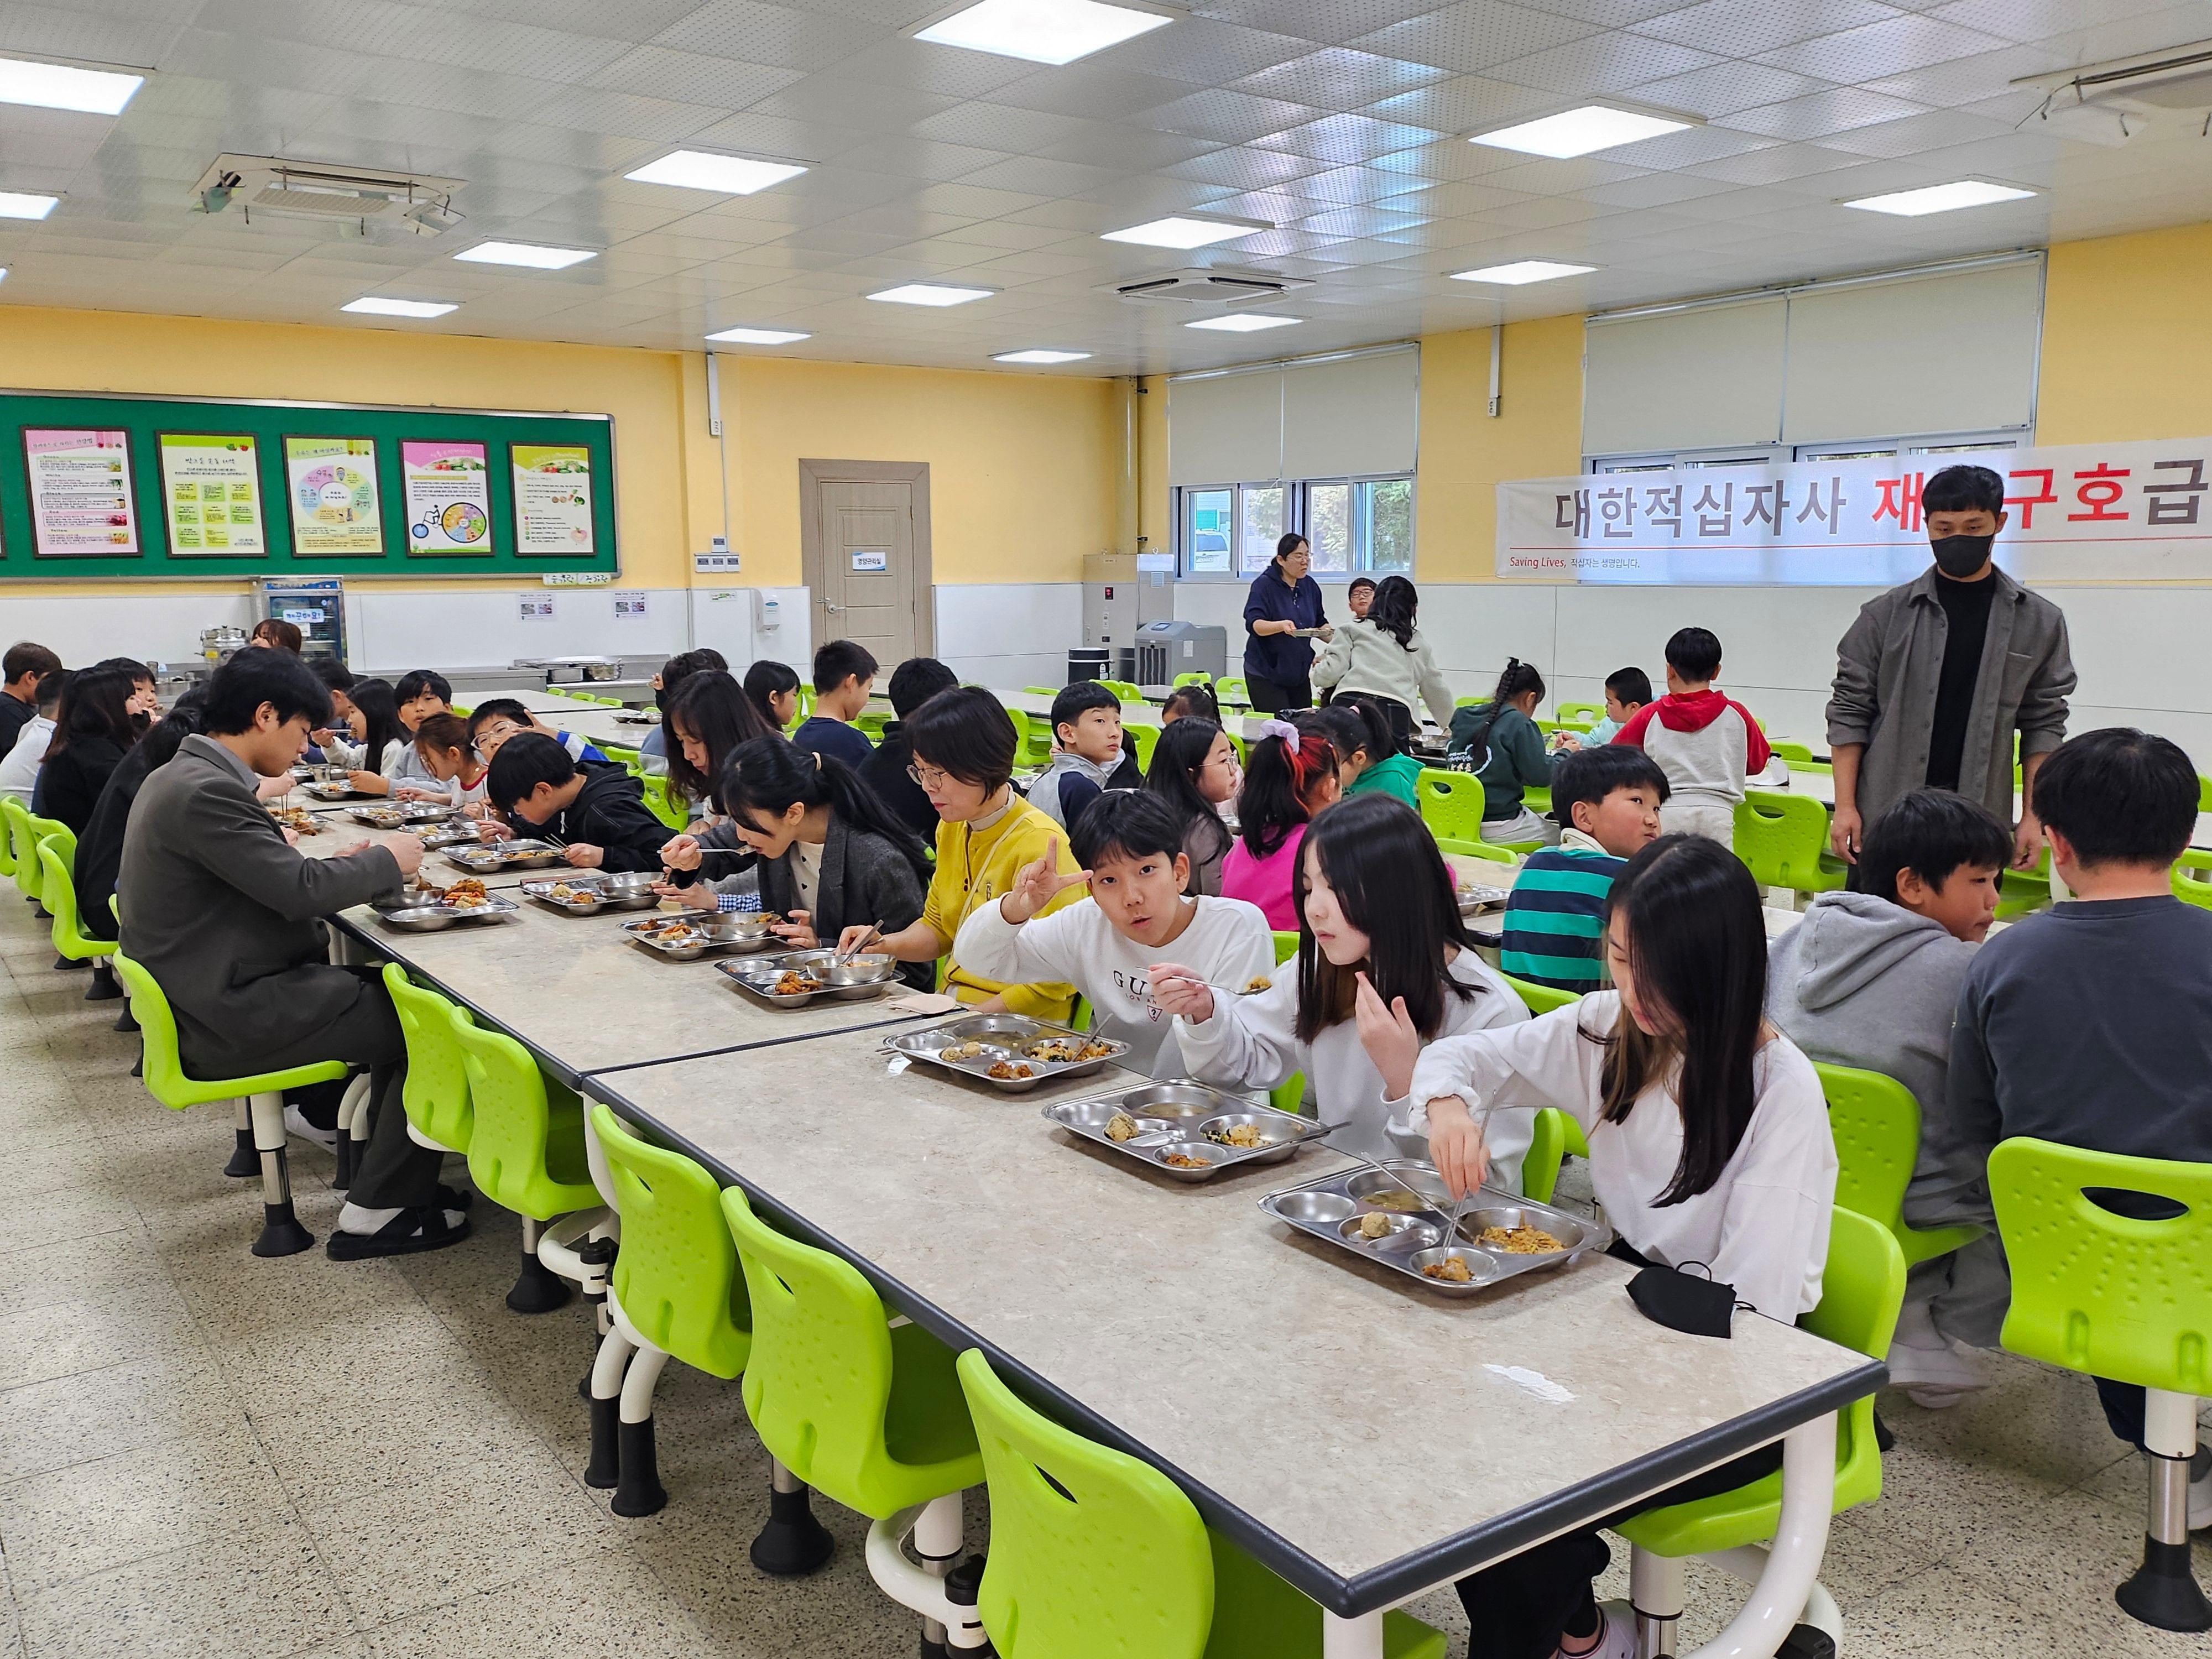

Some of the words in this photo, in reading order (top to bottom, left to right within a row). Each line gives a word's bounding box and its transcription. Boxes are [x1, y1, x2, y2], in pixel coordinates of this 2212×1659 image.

[1555, 474, 1847, 539] 대한적십자사
[1872, 459, 2209, 533] 재구호급
[1510, 557, 1538, 569] Saving
[1541, 557, 1567, 568] Lives,
[1571, 559, 1600, 568] 적십자는
[1601, 558, 1640, 568] 생명입니다.
[1113, 970, 1154, 997] GU
